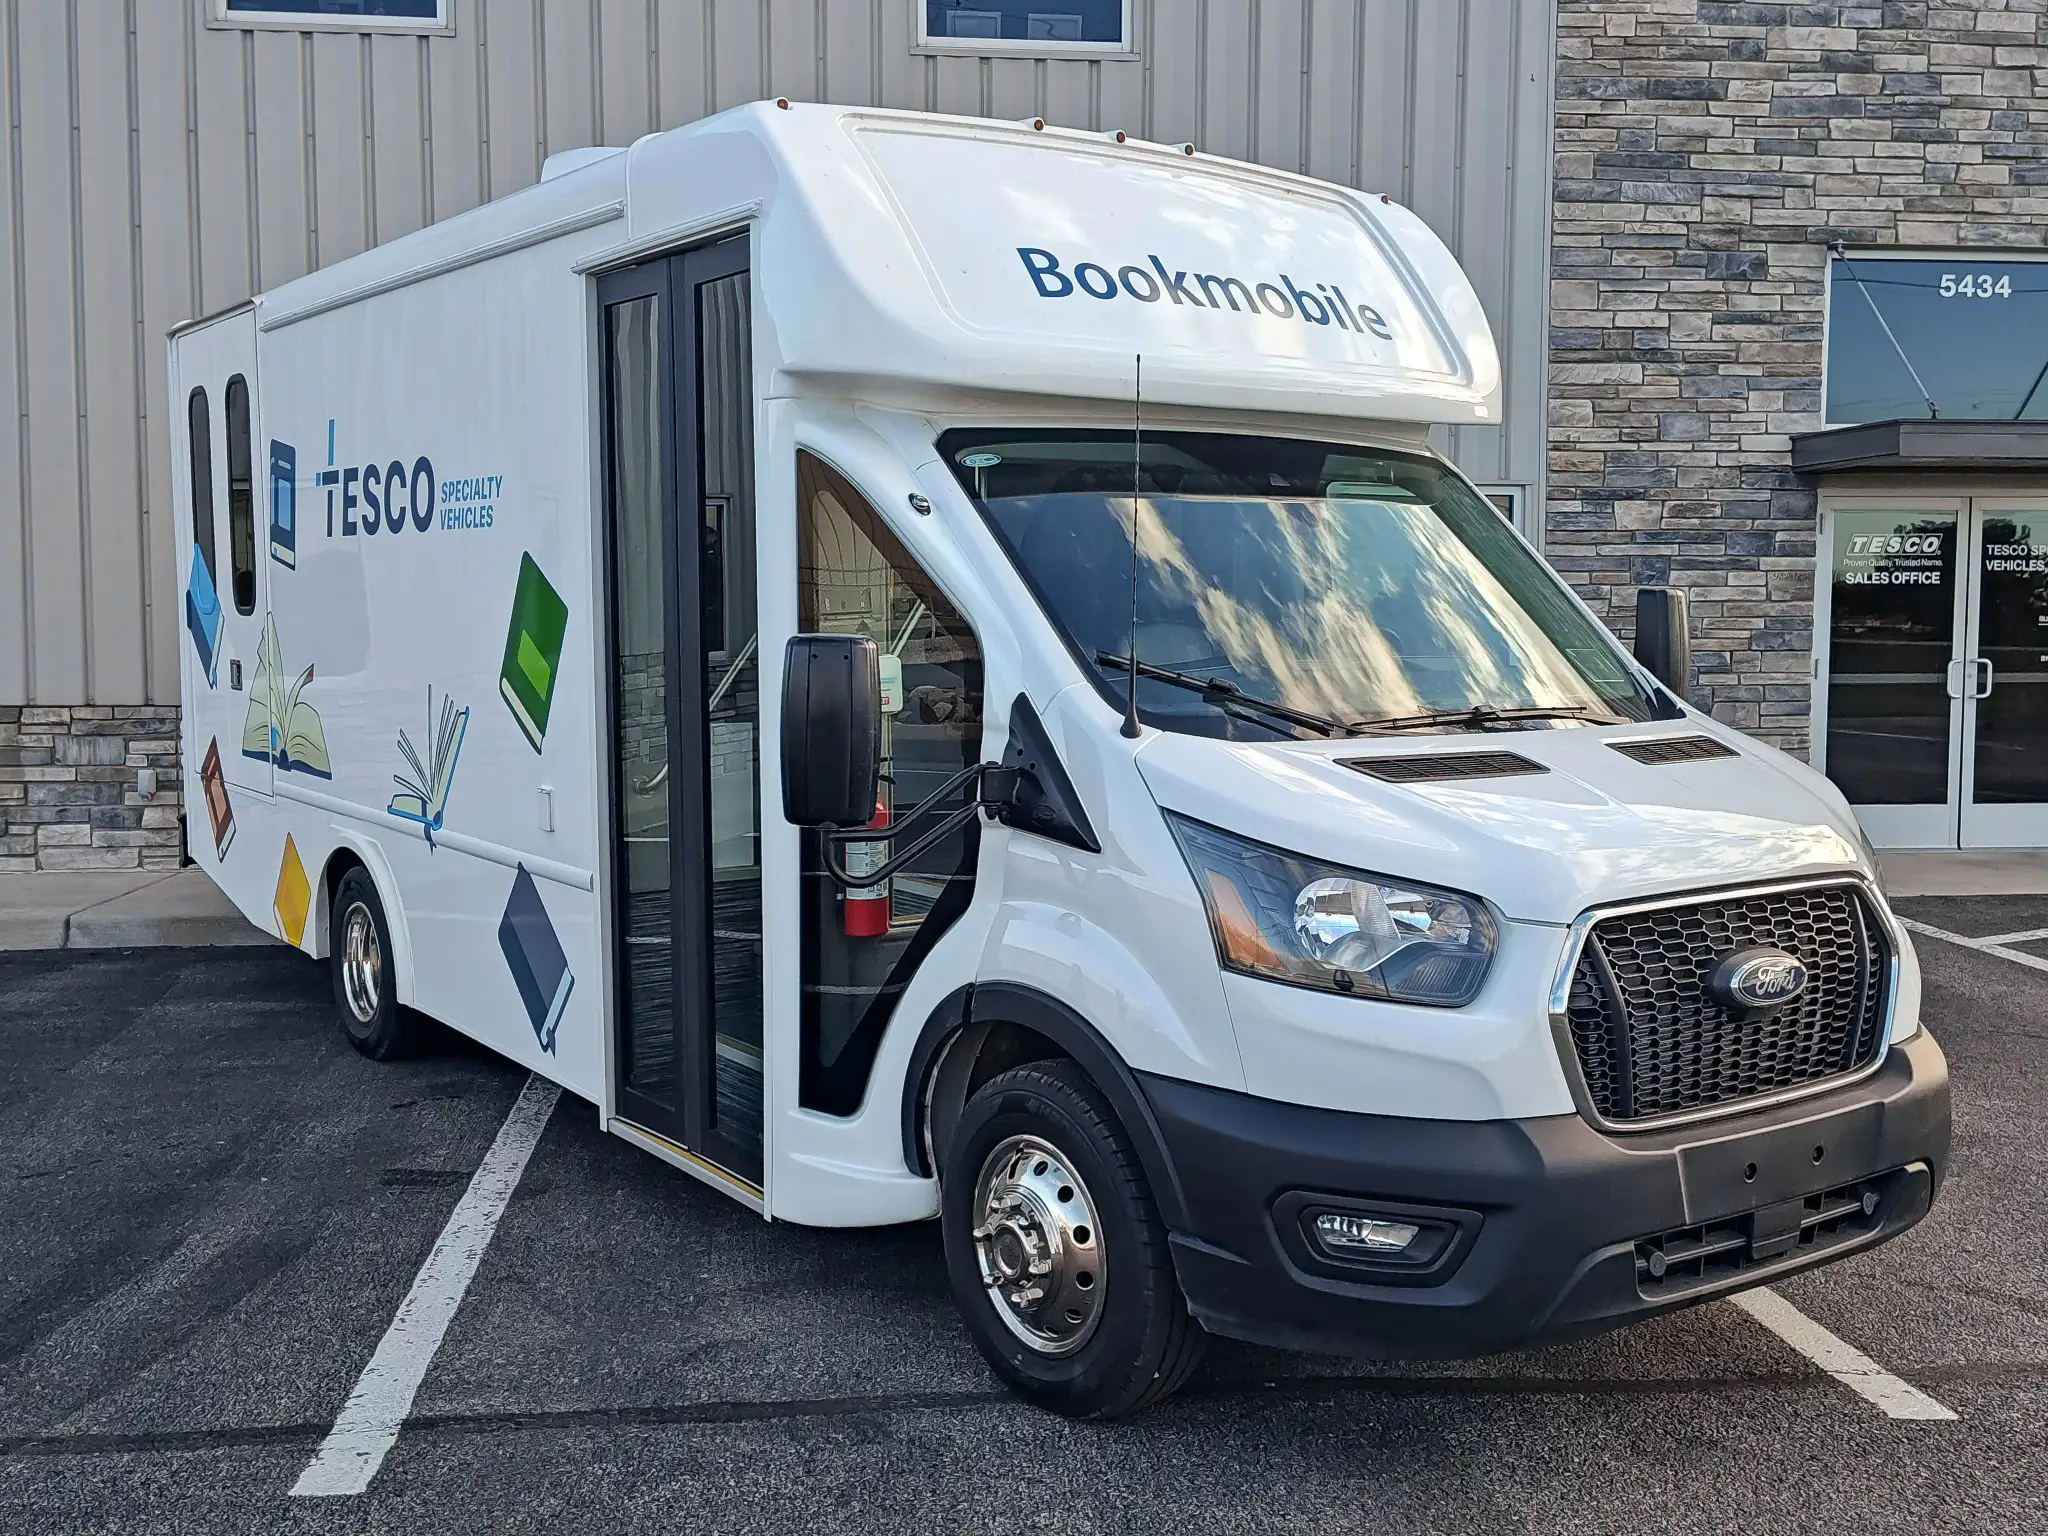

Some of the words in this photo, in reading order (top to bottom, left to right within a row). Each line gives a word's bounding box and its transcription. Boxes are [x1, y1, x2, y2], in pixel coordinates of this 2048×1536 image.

[1016, 247, 1393, 341] Bookmobile
[1940, 274, 2012, 298] 5434
[316, 456, 435, 538] TESCO
[441, 475, 503, 503] SPECIALTY
[440, 505, 494, 530] VEHICLES
[1852, 536, 1940, 553] TESCO
[1986, 544, 2028, 556] TESCO
[2030, 544, 2048, 556] SP
[1843, 558, 1867, 567] Proven
[1894, 558, 1920, 567] Trusted
[1845, 571, 1890, 585] SALES
[1891, 571, 1940, 585] OFFICE
[1755, 966, 1796, 995] Ford
